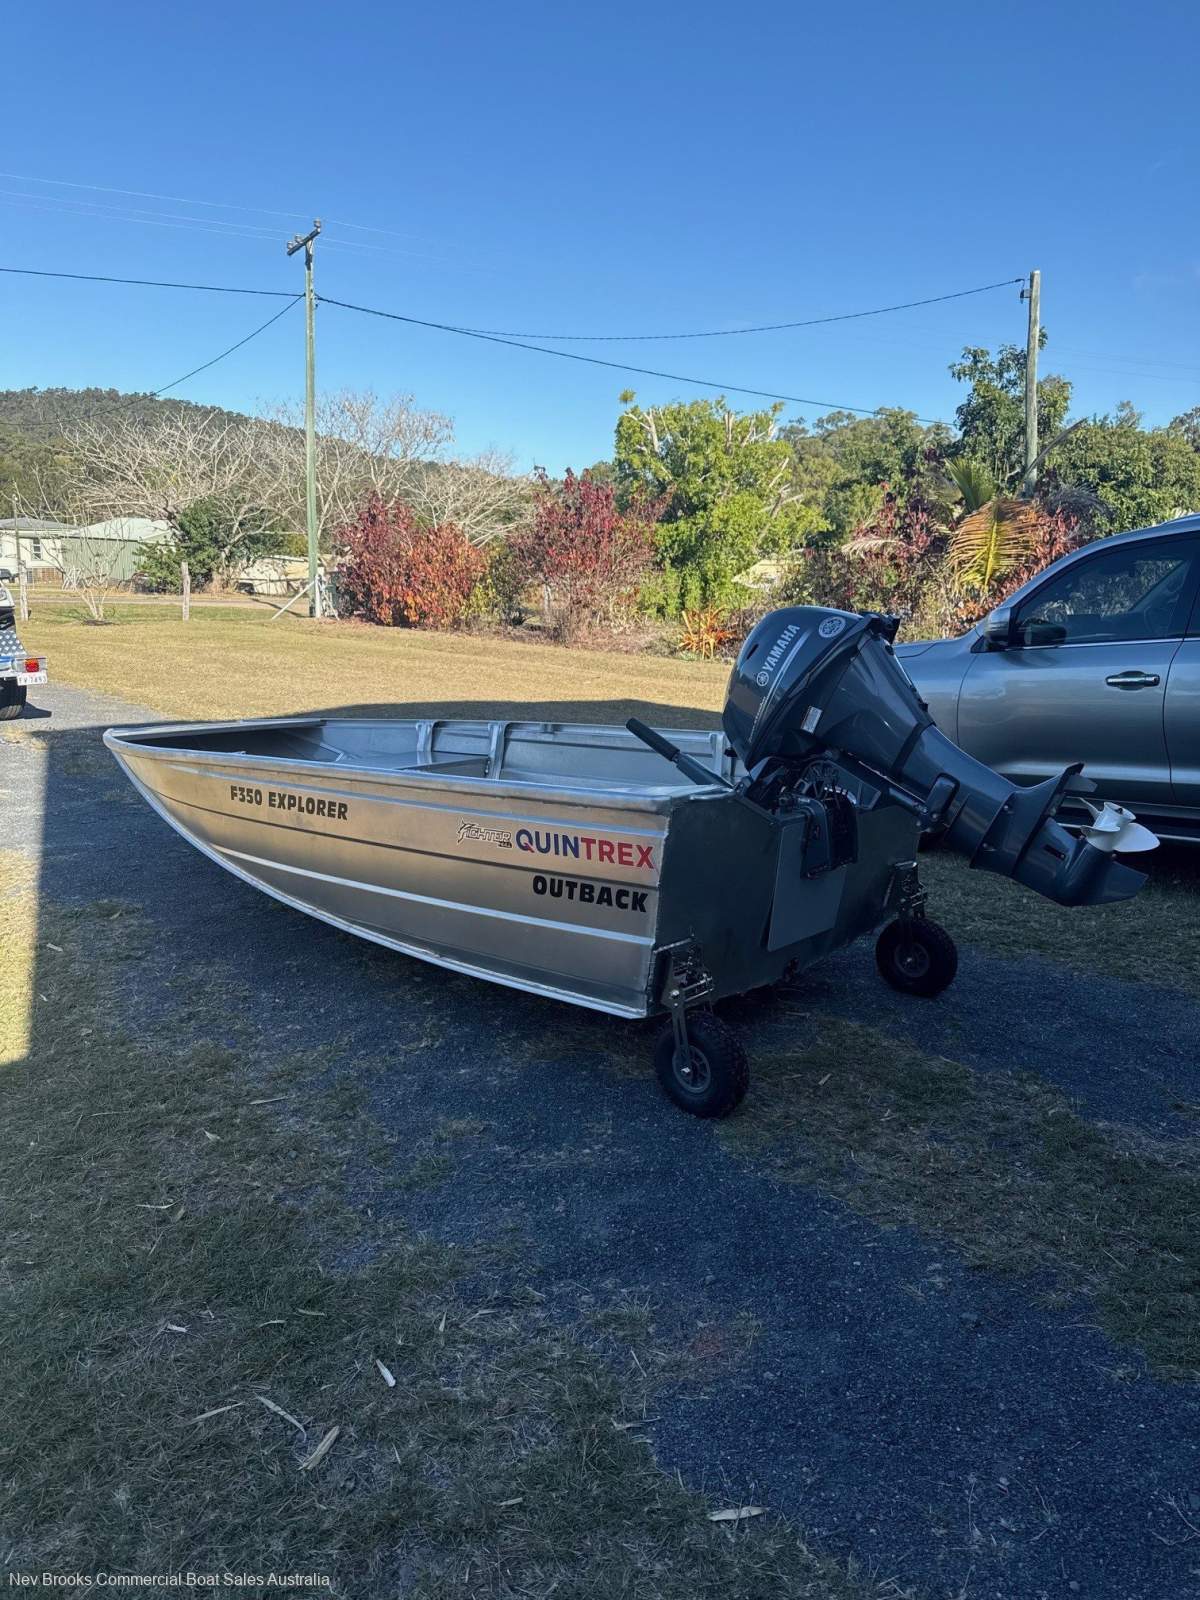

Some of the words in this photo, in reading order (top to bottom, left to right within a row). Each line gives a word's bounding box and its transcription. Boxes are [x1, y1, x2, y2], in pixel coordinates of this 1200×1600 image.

[762, 624, 800, 672] YAMAHA
[230, 785, 263, 806] F350
[268, 791, 348, 821] EXPLORER
[515, 828, 654, 869] QUINTREX
[532, 875, 649, 913] OUTBACK
